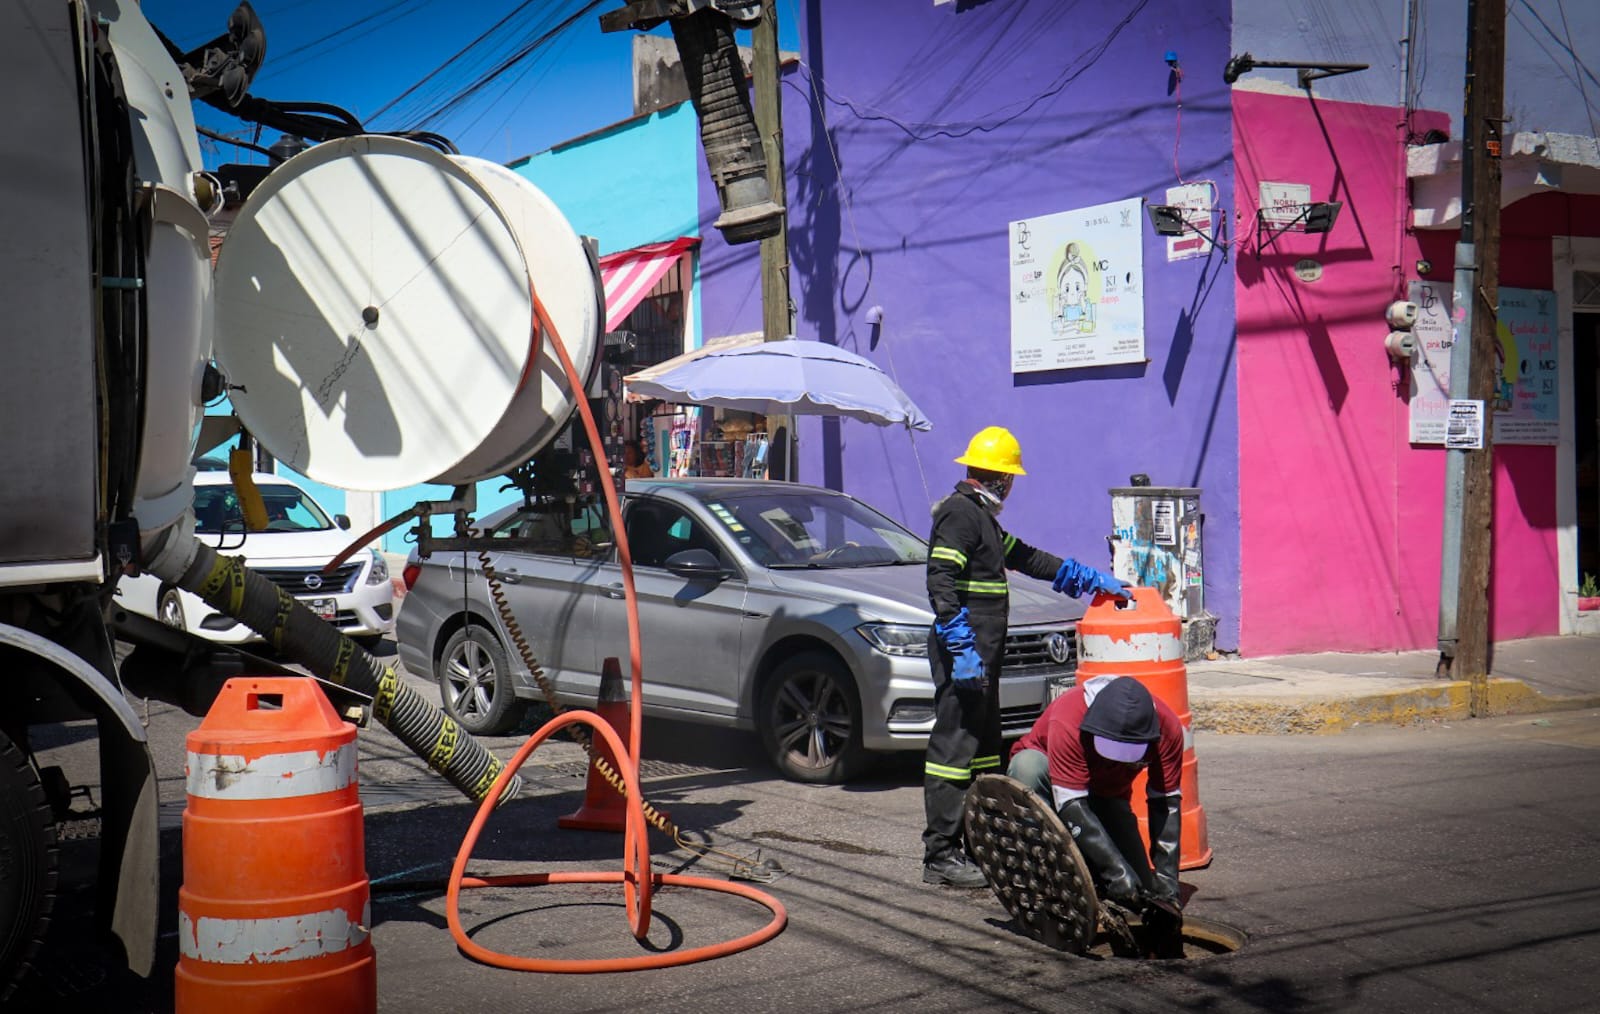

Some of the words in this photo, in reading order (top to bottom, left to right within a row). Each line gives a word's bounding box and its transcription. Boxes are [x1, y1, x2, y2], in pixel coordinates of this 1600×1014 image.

[1273, 199, 1297, 207] NORTE
[1271, 207, 1300, 215] CENTRO
[1092, 259, 1109, 272] MC
[1426, 340, 1440, 350] pink
[1441, 340, 1452, 349] UP
[1539, 359, 1557, 371] MC
